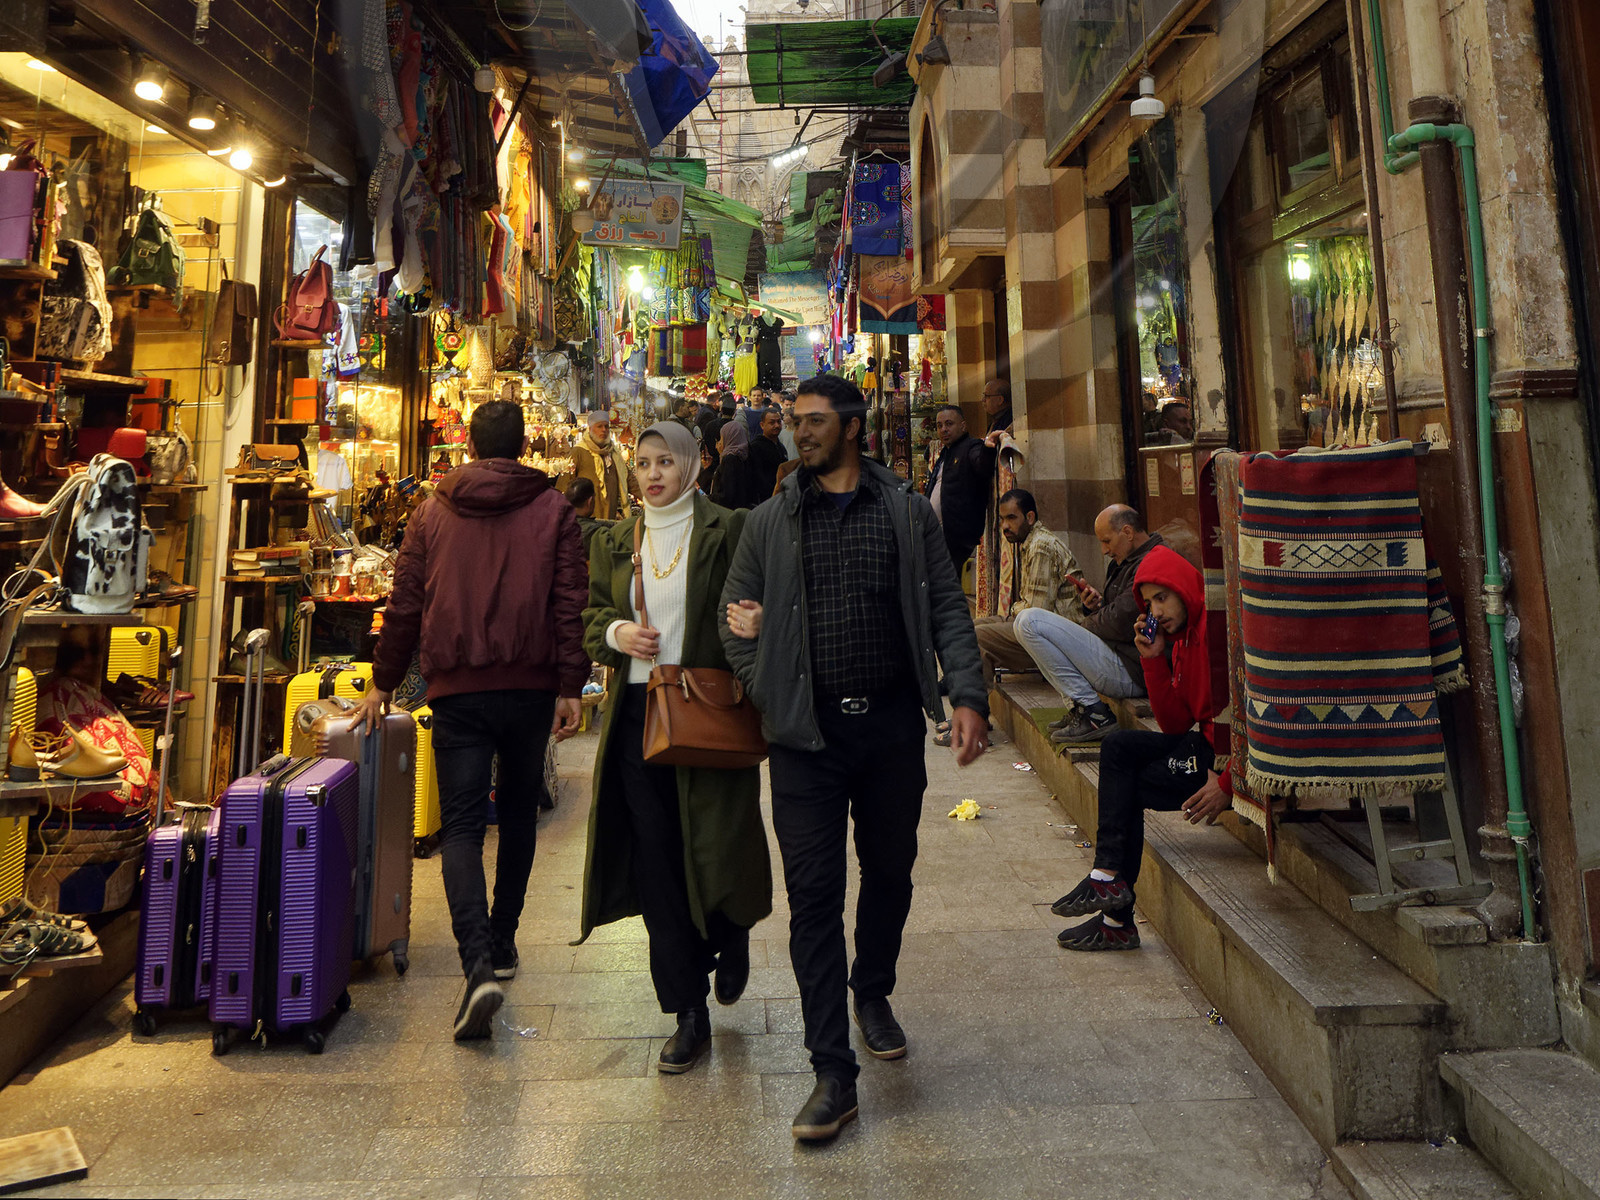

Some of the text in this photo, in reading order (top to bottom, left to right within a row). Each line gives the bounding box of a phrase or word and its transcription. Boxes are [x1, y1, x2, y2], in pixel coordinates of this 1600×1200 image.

[616, 194, 652, 210] بازار
[618, 210, 646, 225] الحاج
[595, 223, 666, 243] رجب رزق
